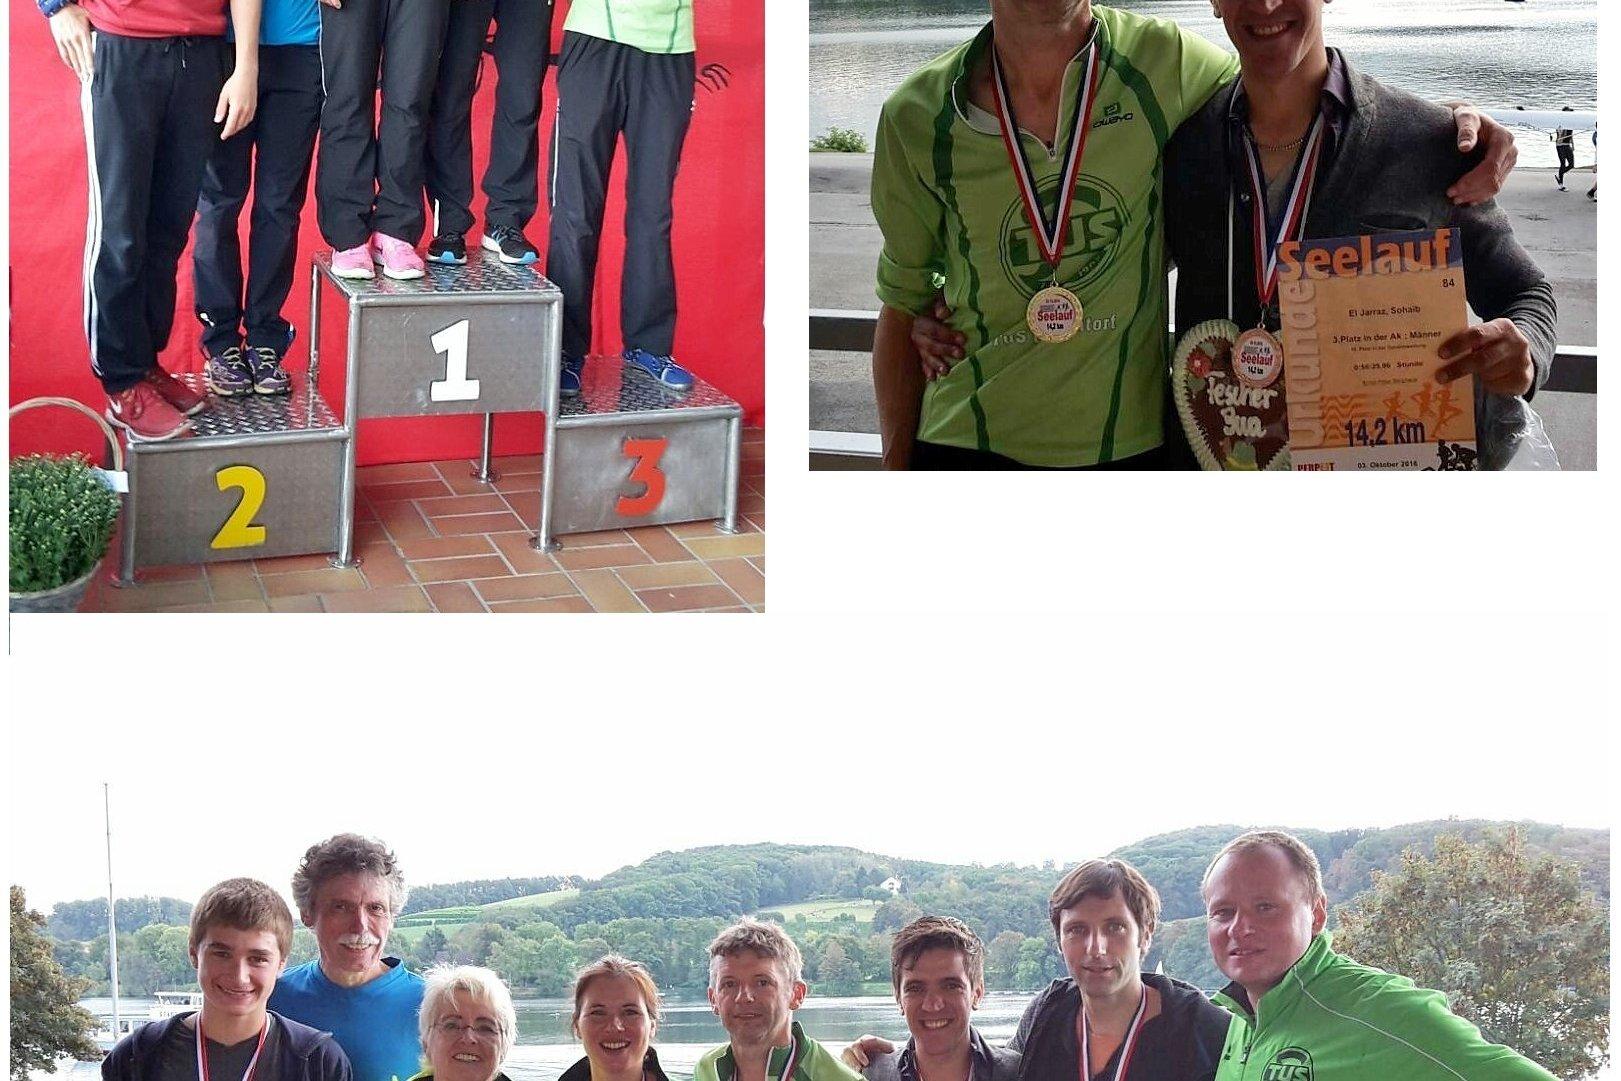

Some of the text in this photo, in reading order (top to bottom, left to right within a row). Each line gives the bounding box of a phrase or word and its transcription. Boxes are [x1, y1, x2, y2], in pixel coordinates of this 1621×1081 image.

[1278, 228, 1452, 280] Seelauf
[1442, 277, 1455, 288] 84
[1037, 309, 1073, 322] Seelauf
[1348, 305, 1421, 317] El Jarraz, Sohaib
[1373, 333, 1388, 341] der
[1390, 332, 1401, 340] Ak
[1409, 330, 1441, 339] Männer
[430, 319, 480, 402] 1
[1240, 352, 1274, 366] Seelauf
[1284, 279, 1326, 448] Urkunde
[1344, 417, 1425, 448] 14,2 km
[614, 438, 669, 517] 3
[210, 465, 267, 549] 2
[1268, 1064, 1309, 1081] TUS
